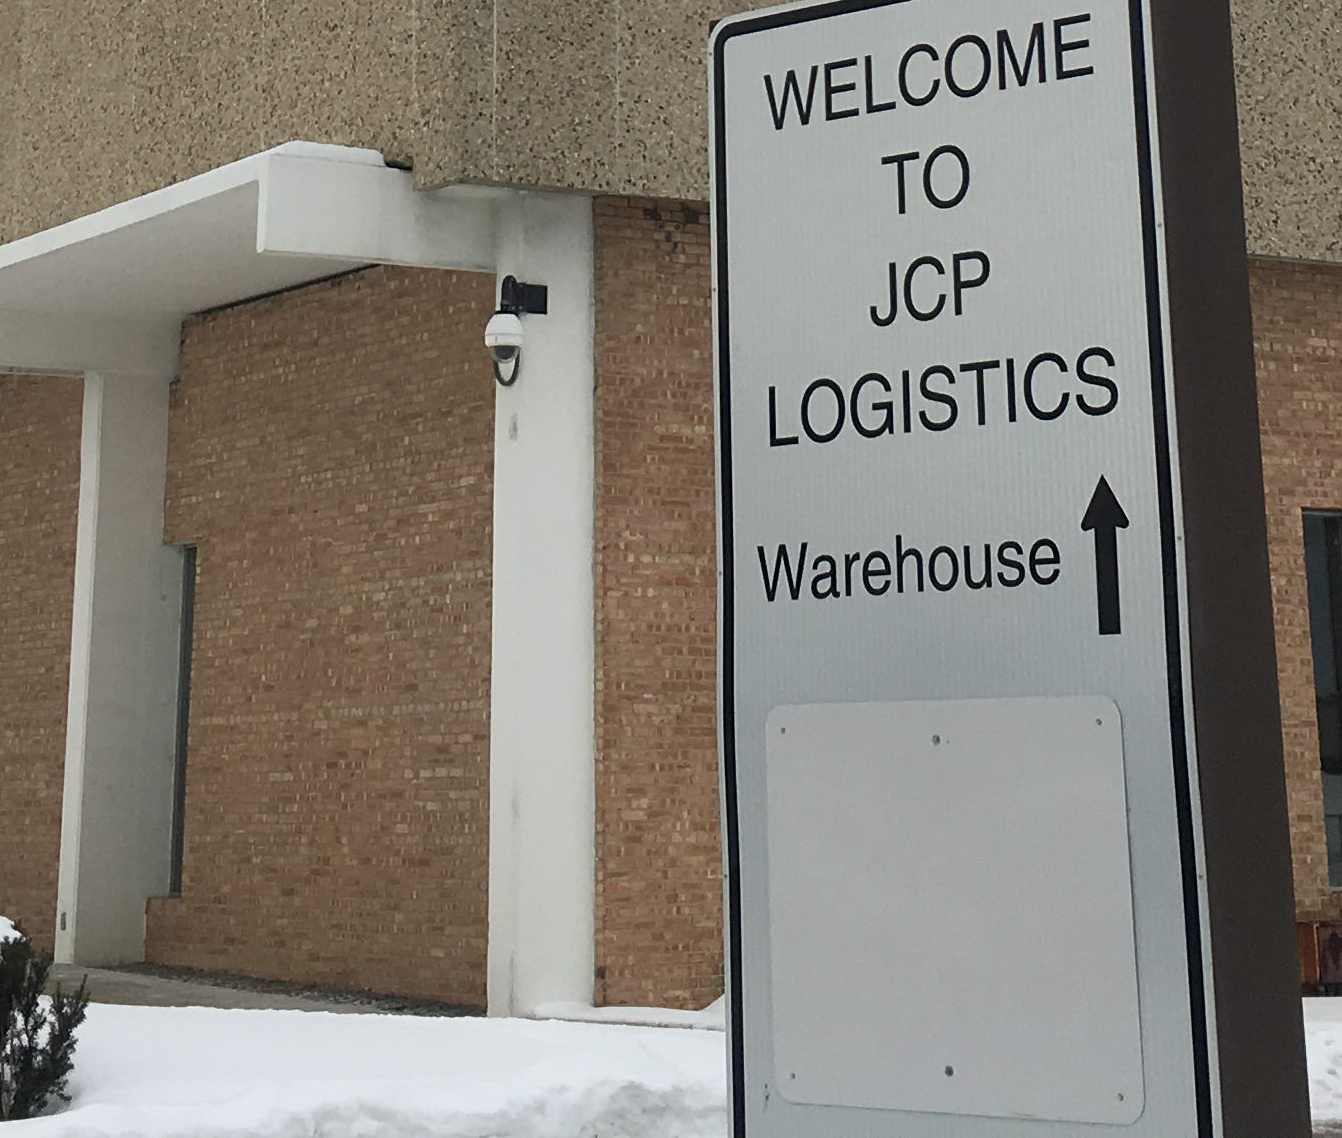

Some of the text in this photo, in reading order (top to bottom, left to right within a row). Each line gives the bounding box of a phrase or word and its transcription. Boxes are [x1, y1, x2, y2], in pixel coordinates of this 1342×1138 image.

[764, 13, 1094, 130] WELCOME
[881, 144, 970, 214] TO
[870, 250, 991, 326] JCP
[767, 347, 1119, 446] LOGISTICS
[757, 535, 1061, 602] Warehouse
